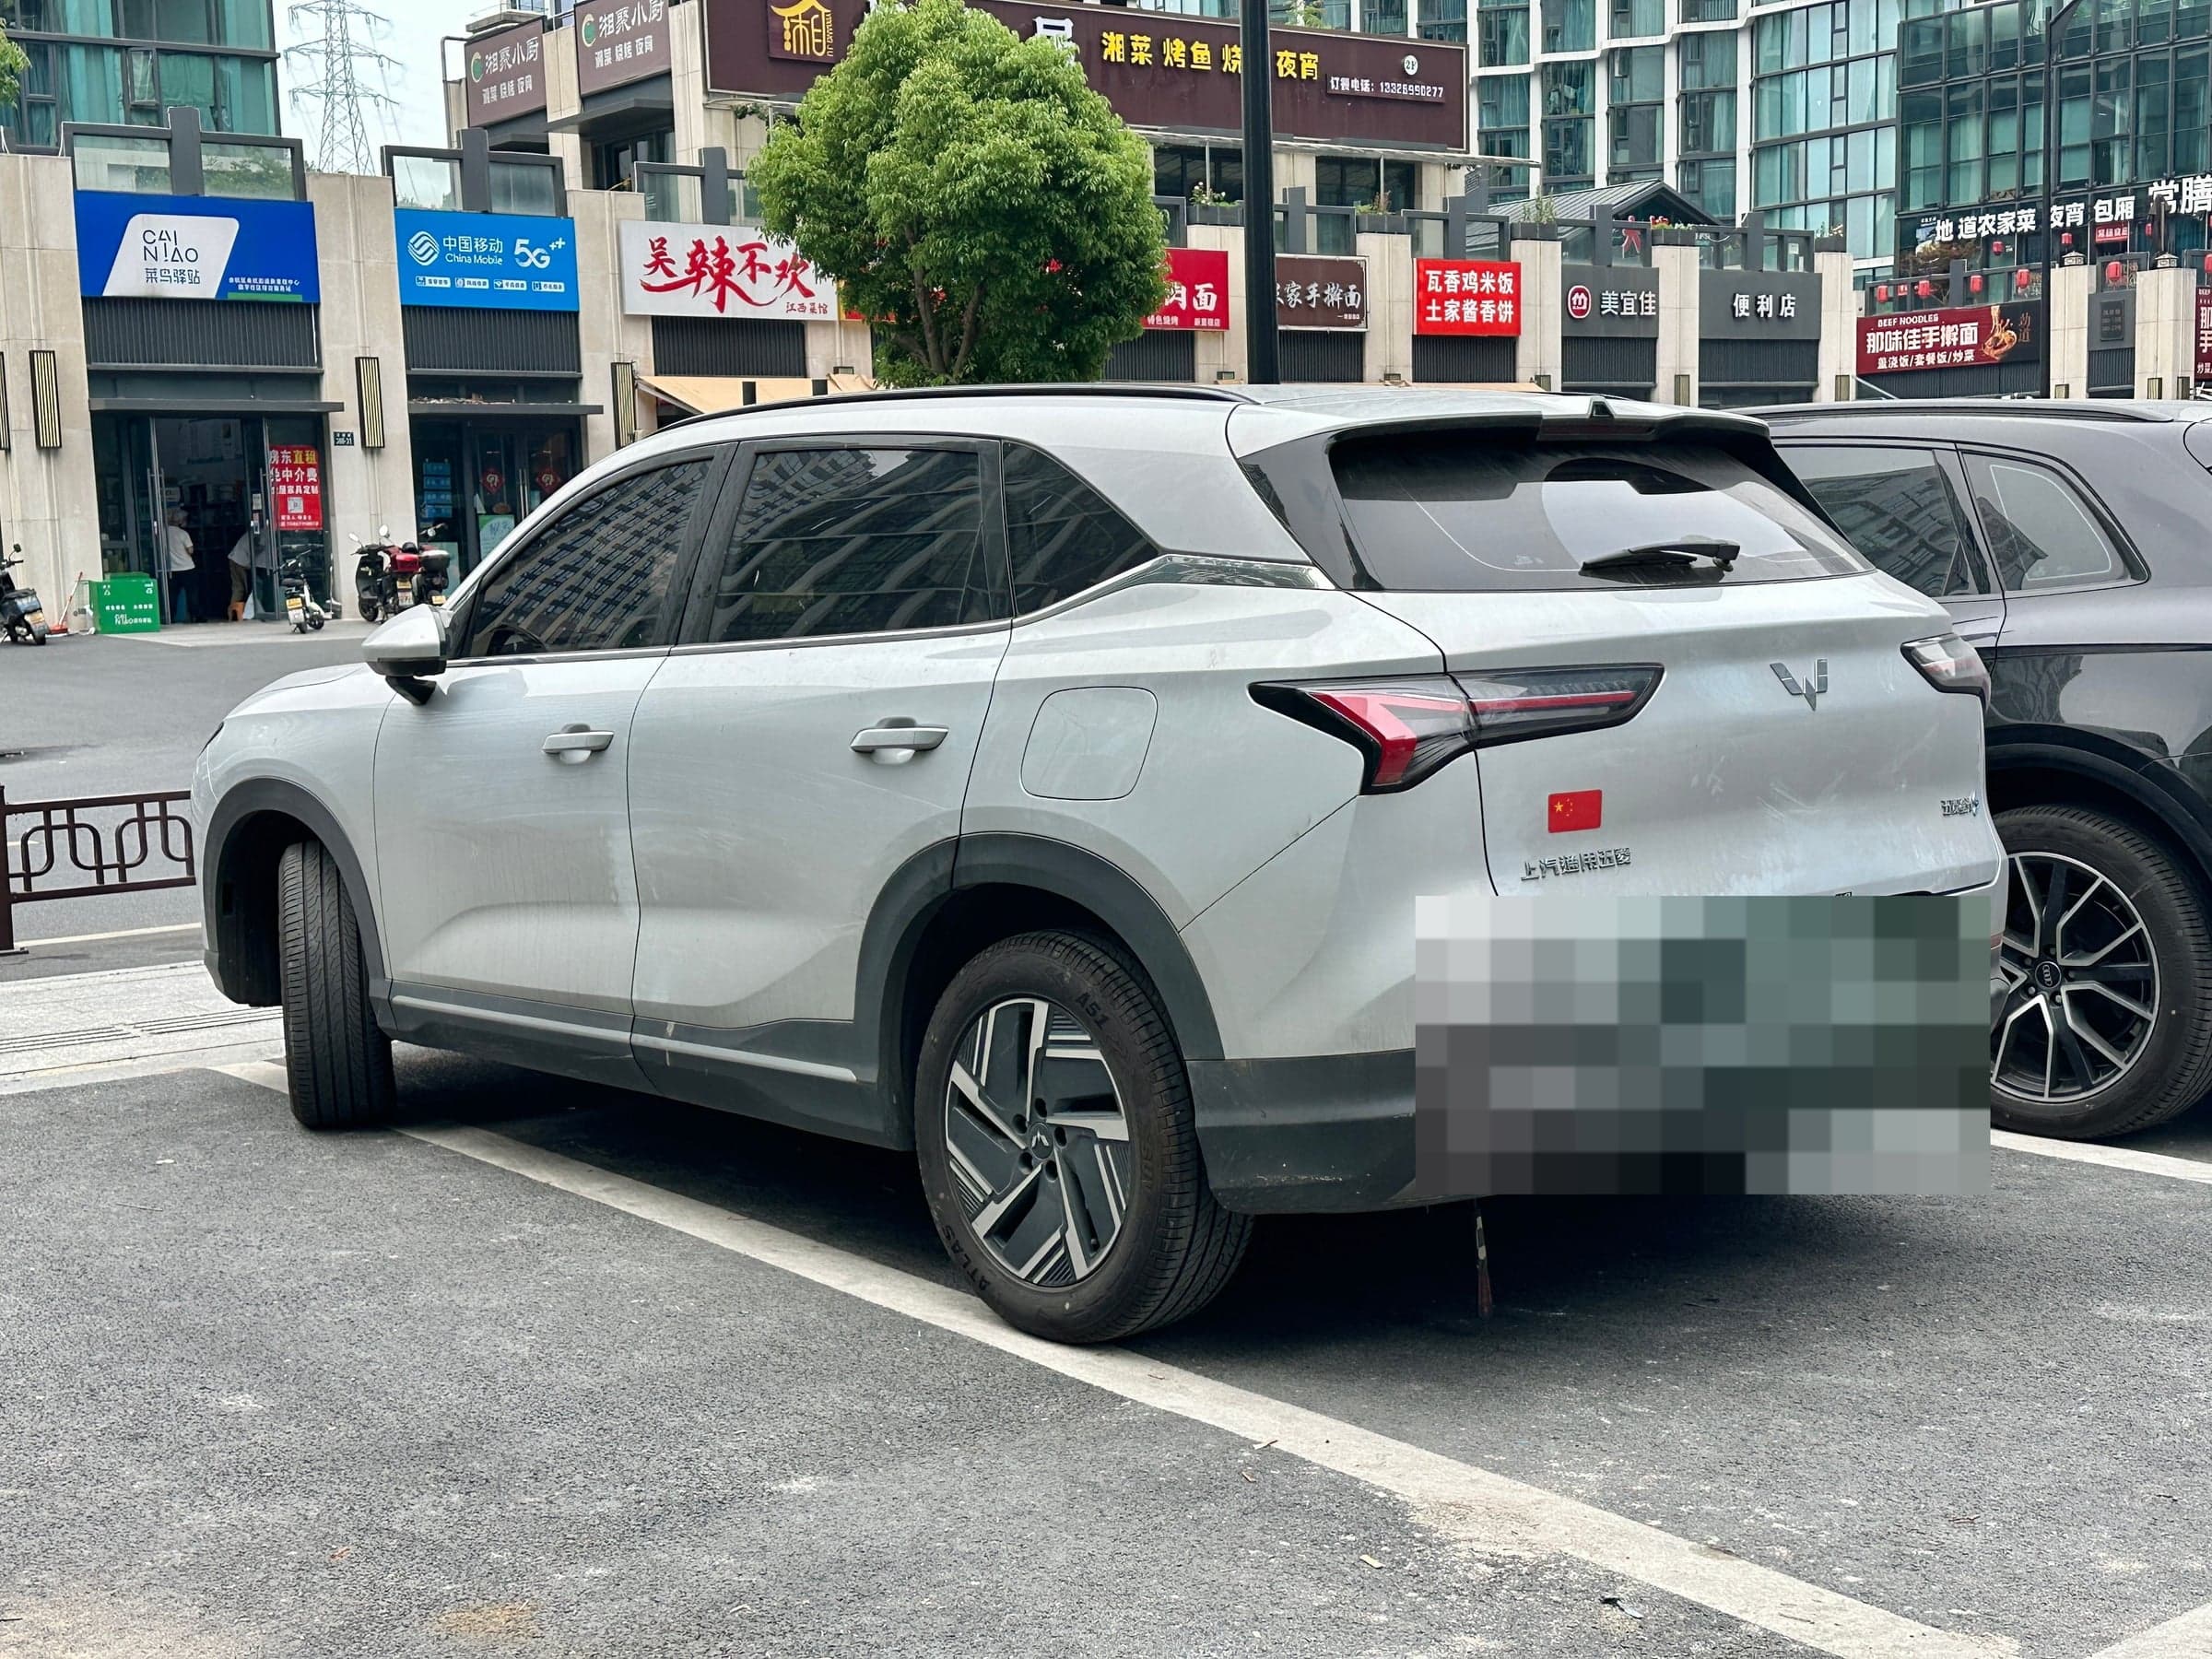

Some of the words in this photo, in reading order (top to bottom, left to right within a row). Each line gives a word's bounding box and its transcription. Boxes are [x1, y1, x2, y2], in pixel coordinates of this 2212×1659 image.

[599, 0, 665, 38] 湘聚小厨
[485, 36, 539, 75] 湘聚小厨
[1101, 31, 1152, 65] 湘菜
[1162, 38, 1212, 70] 烤鱼
[1277, 50, 1319, 80] 夜宵
[1935, 207, 2037, 242] 地道农家菜
[2050, 202, 2085, 229] 夜宵
[2093, 195, 2136, 224] 包厢
[443, 235, 503, 253] 中国移动
[445, 253, 472, 264] China
[474, 254, 503, 265] Mobile
[145, 267, 201, 284] 菜鸟驿站
[640, 235, 816, 314] 吴辣不欢
[1425, 269, 1514, 295] 瓦香鸡米饭
[1425, 298, 1514, 324] 土家酱香饼
[1600, 290, 1657, 316] 美宜佳
[1733, 292, 1796, 318] 便利店
[1877, 318, 1898, 328] BEEF
[1900, 313, 1939, 325] NOODLES
[1865, 322, 1979, 354] 那味佳手擀面
[1521, 847, 1631, 881] 上汽通用五菱
